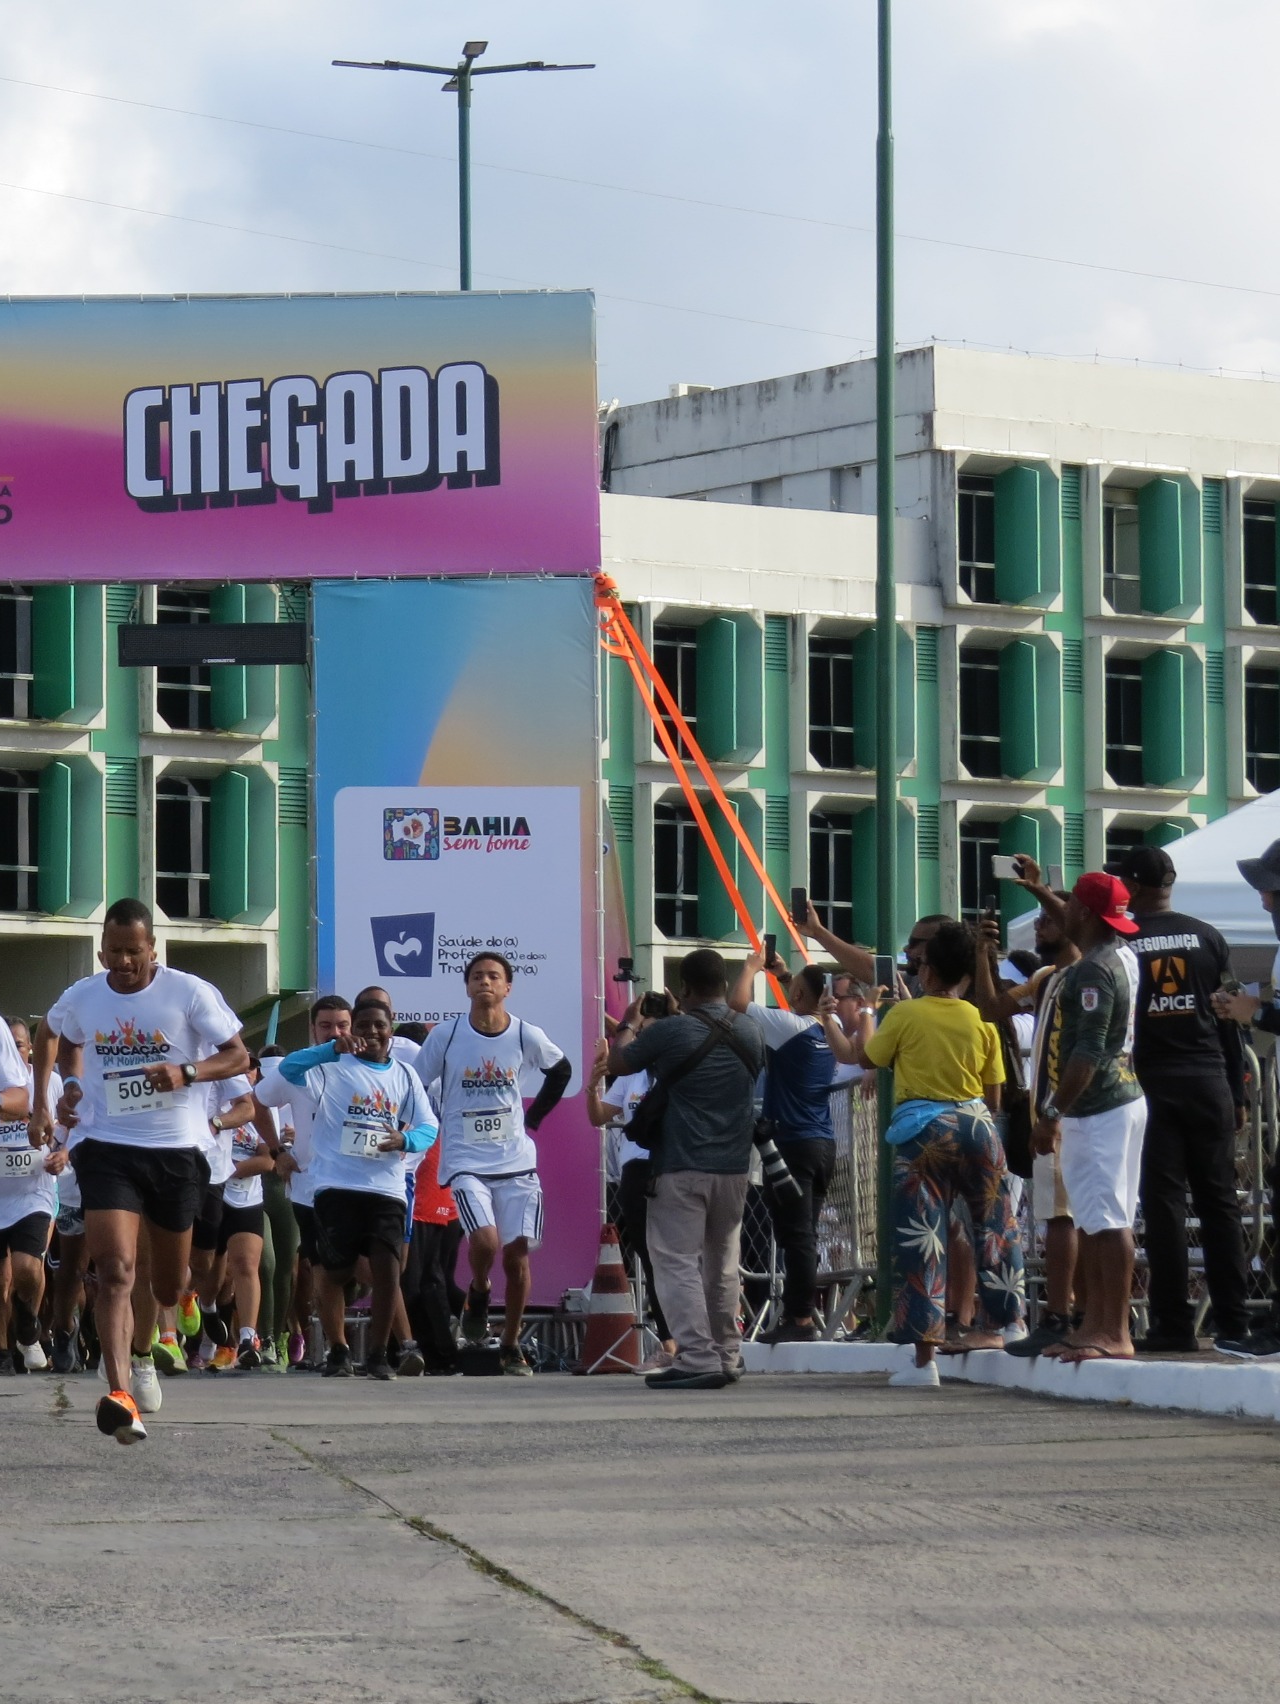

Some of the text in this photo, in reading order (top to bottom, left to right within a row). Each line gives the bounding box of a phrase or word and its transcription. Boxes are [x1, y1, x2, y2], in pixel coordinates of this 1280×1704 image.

[123, 360, 500, 514] CHEGADA
[443, 817, 531, 836] BAHIA
[443, 835, 531, 853] sem fome
[438, 934, 482, 947] Saúde
[1130, 933, 1200, 954] SEGURANÇA
[1147, 993, 1195, 1013] ÁPICE
[424, 1012, 440, 1021] DO
[95, 1042, 170, 1058] EDUCAÇÃO
[119, 1080, 154, 1100] 509
[474, 1117, 501, 1132] 689
[353, 1131, 377, 1147] 718
[5, 1153, 32, 1167] 300
